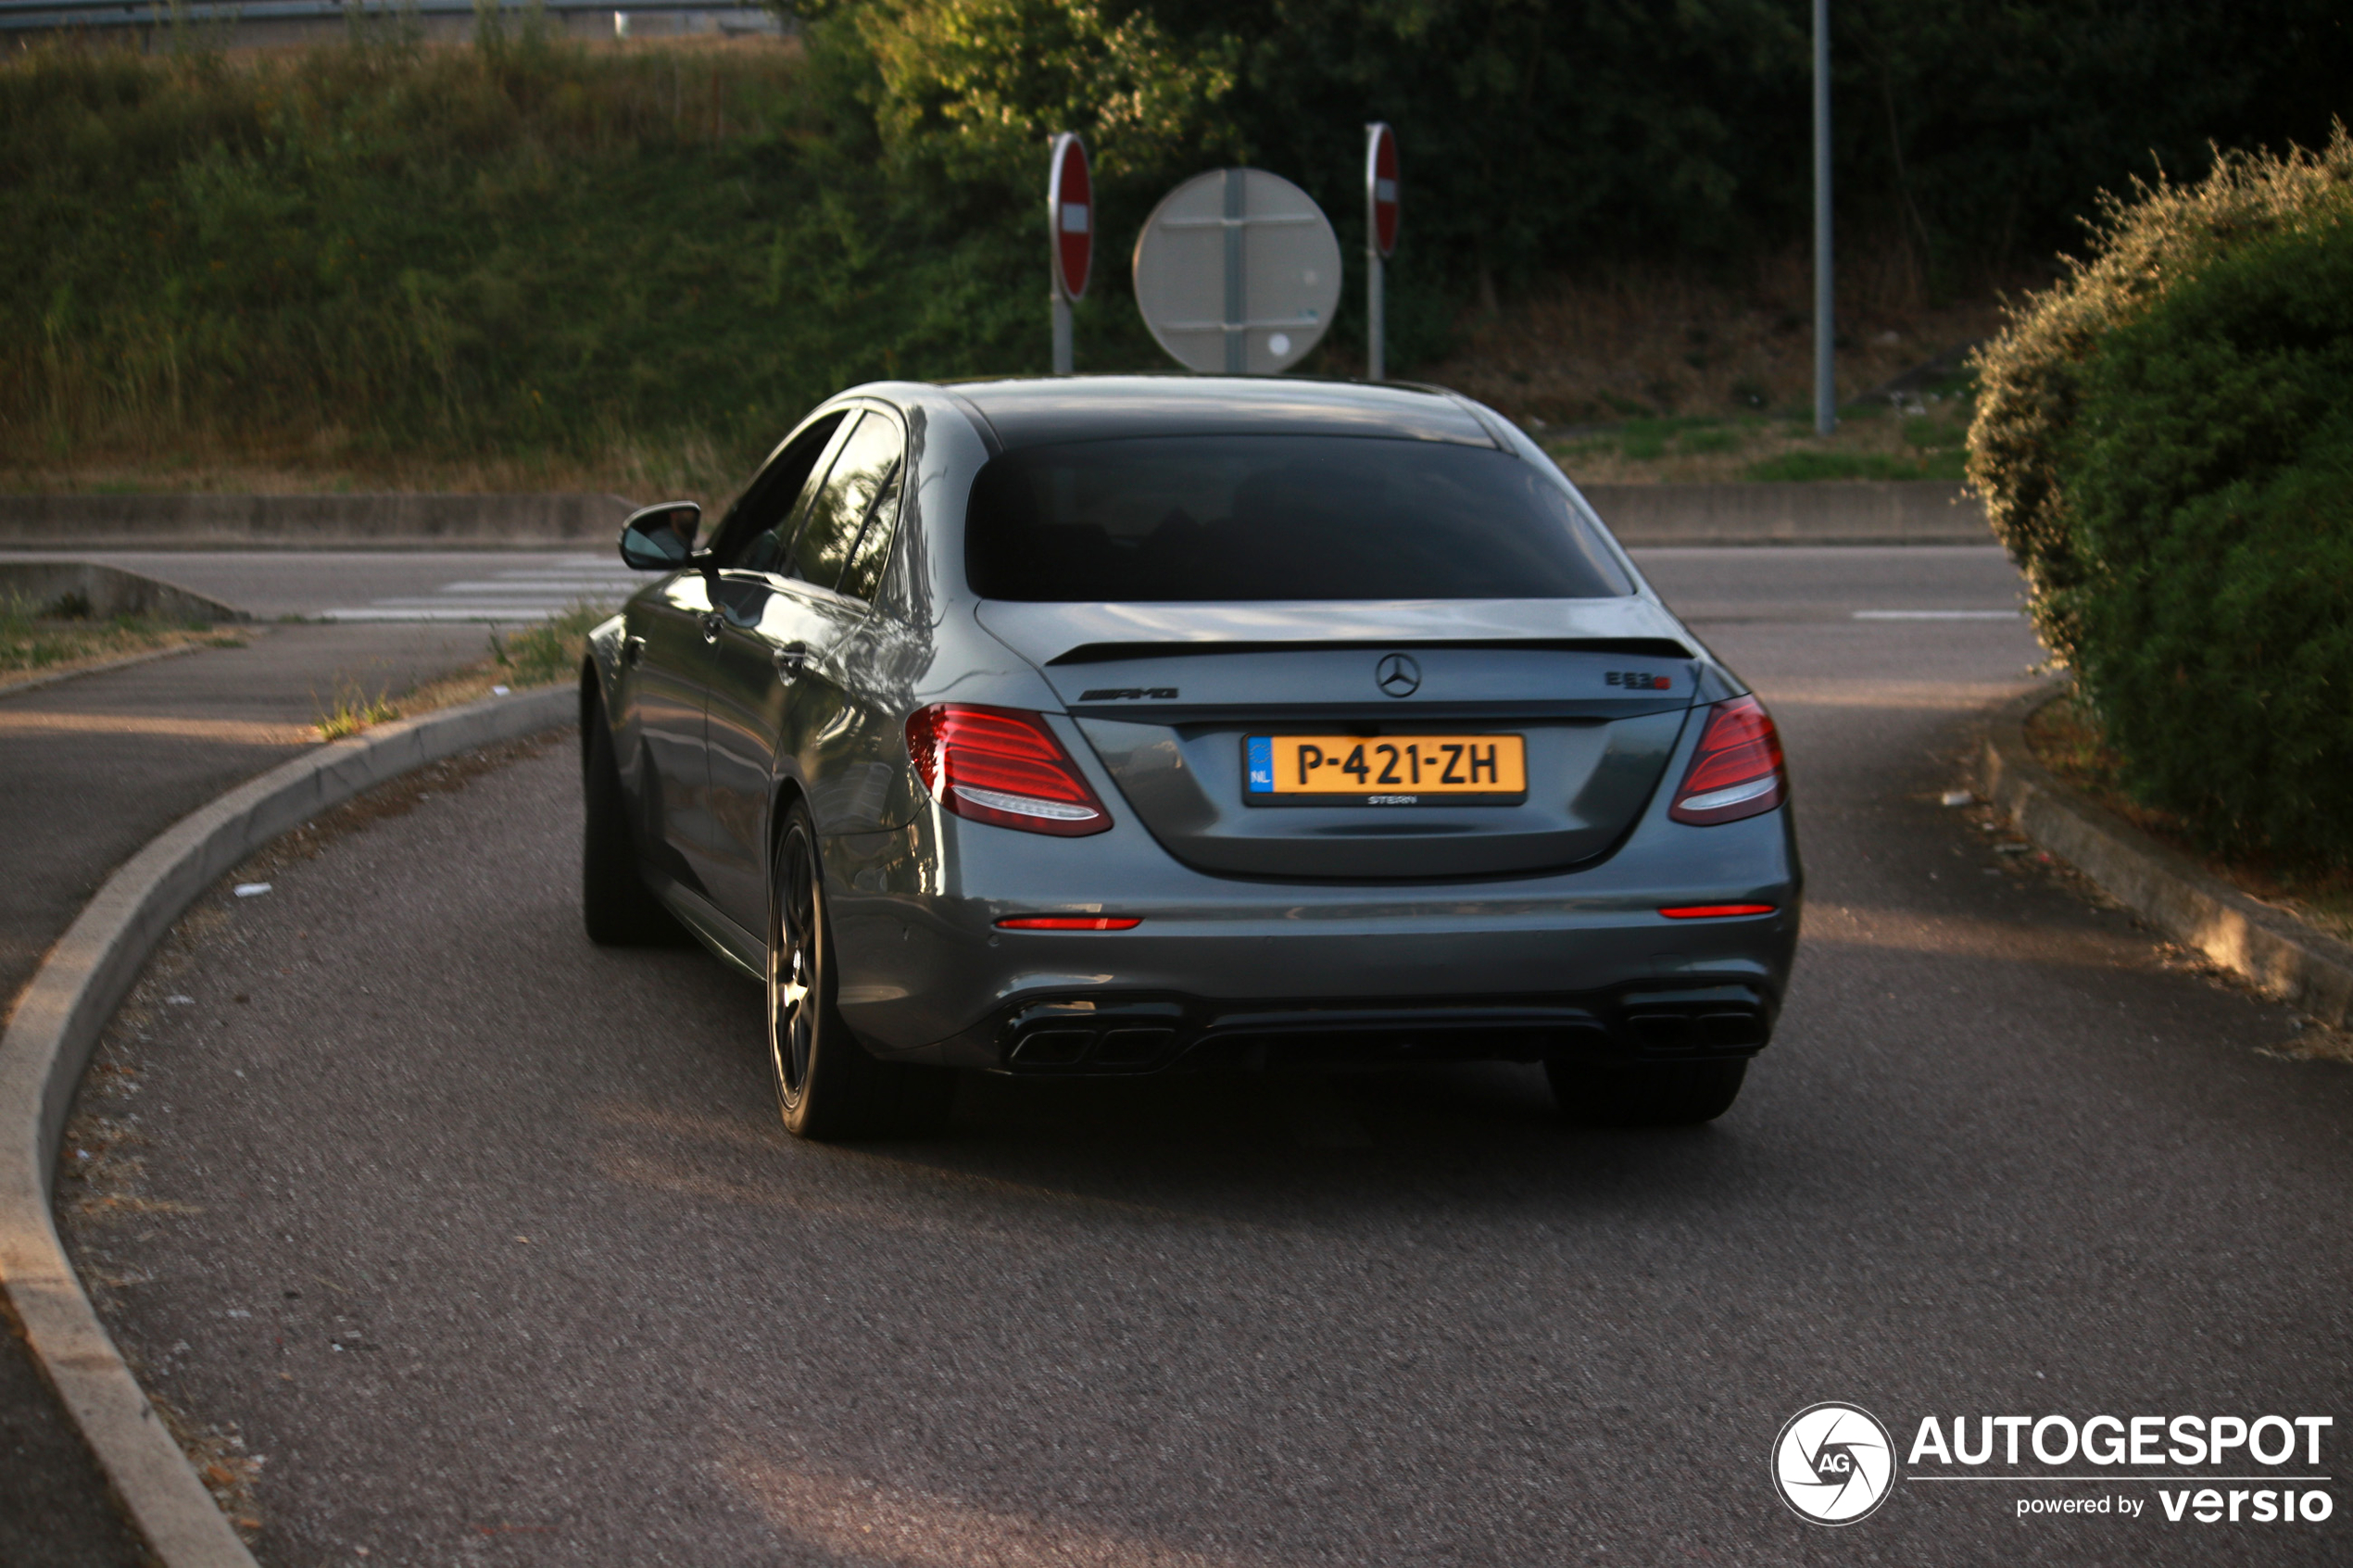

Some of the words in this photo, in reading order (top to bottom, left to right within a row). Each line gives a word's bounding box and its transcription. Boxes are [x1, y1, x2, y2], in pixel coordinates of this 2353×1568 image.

[1298, 744, 1497, 785] P-421-ZH
[1251, 770, 1270, 783] NL
[1367, 796, 1417, 805] STERN
